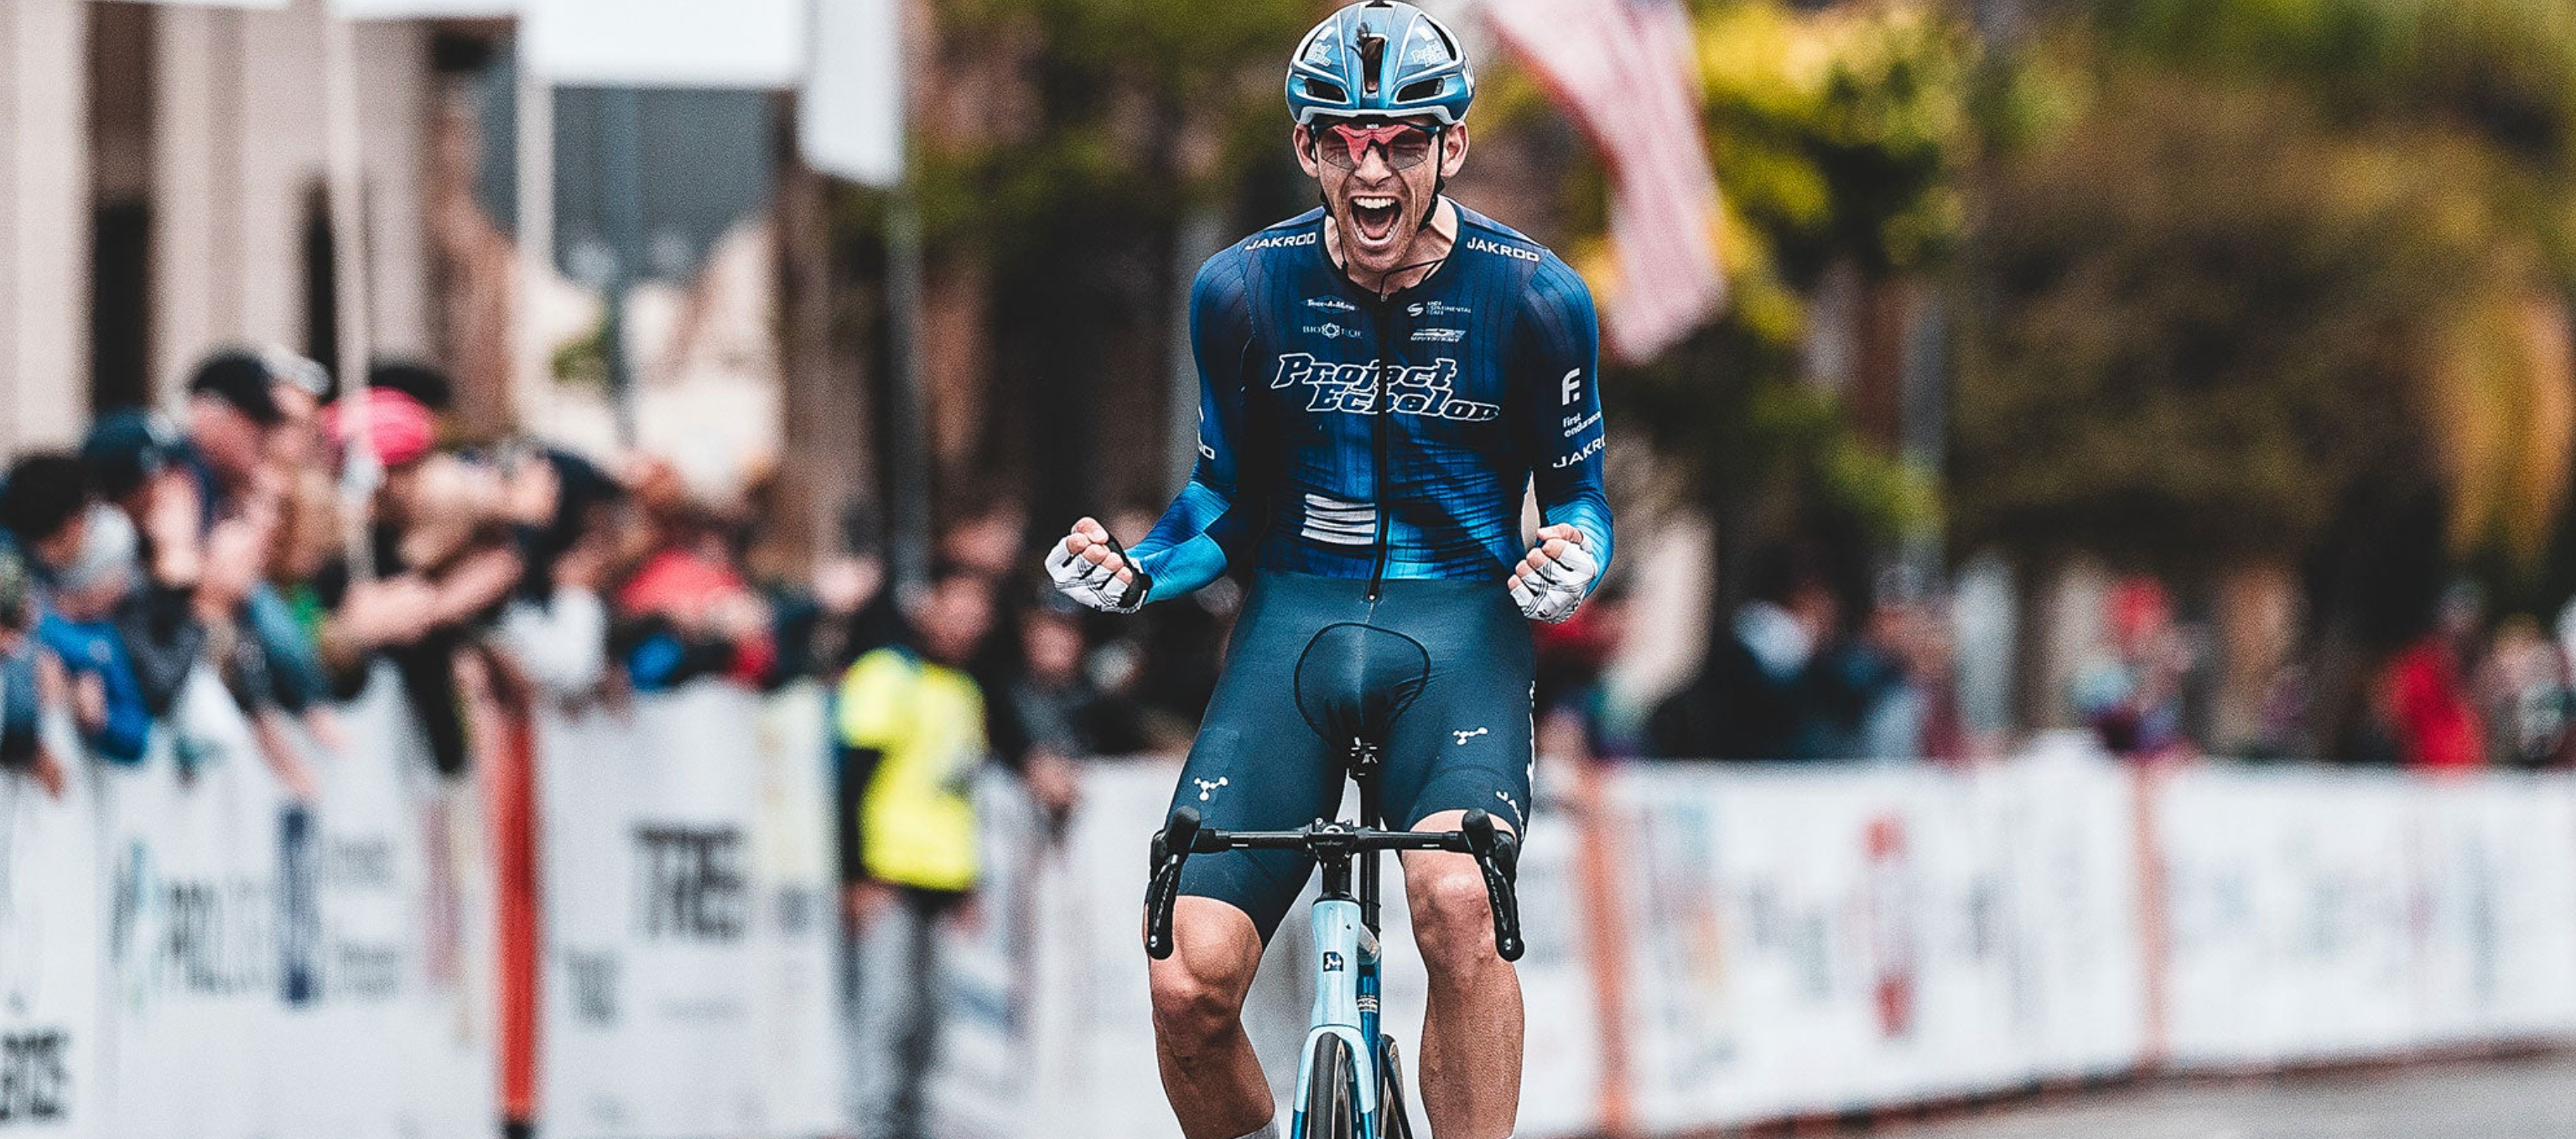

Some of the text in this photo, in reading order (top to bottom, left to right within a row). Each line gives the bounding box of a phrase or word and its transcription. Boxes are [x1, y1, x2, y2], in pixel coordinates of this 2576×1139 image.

[1244, 232, 1317, 250] JAKROO
[1467, 237, 1540, 262] JAKROO
[1270, 352, 1457, 392] Project
[1306, 382, 1500, 421] Echelon
[1563, 413, 1581, 427] first
